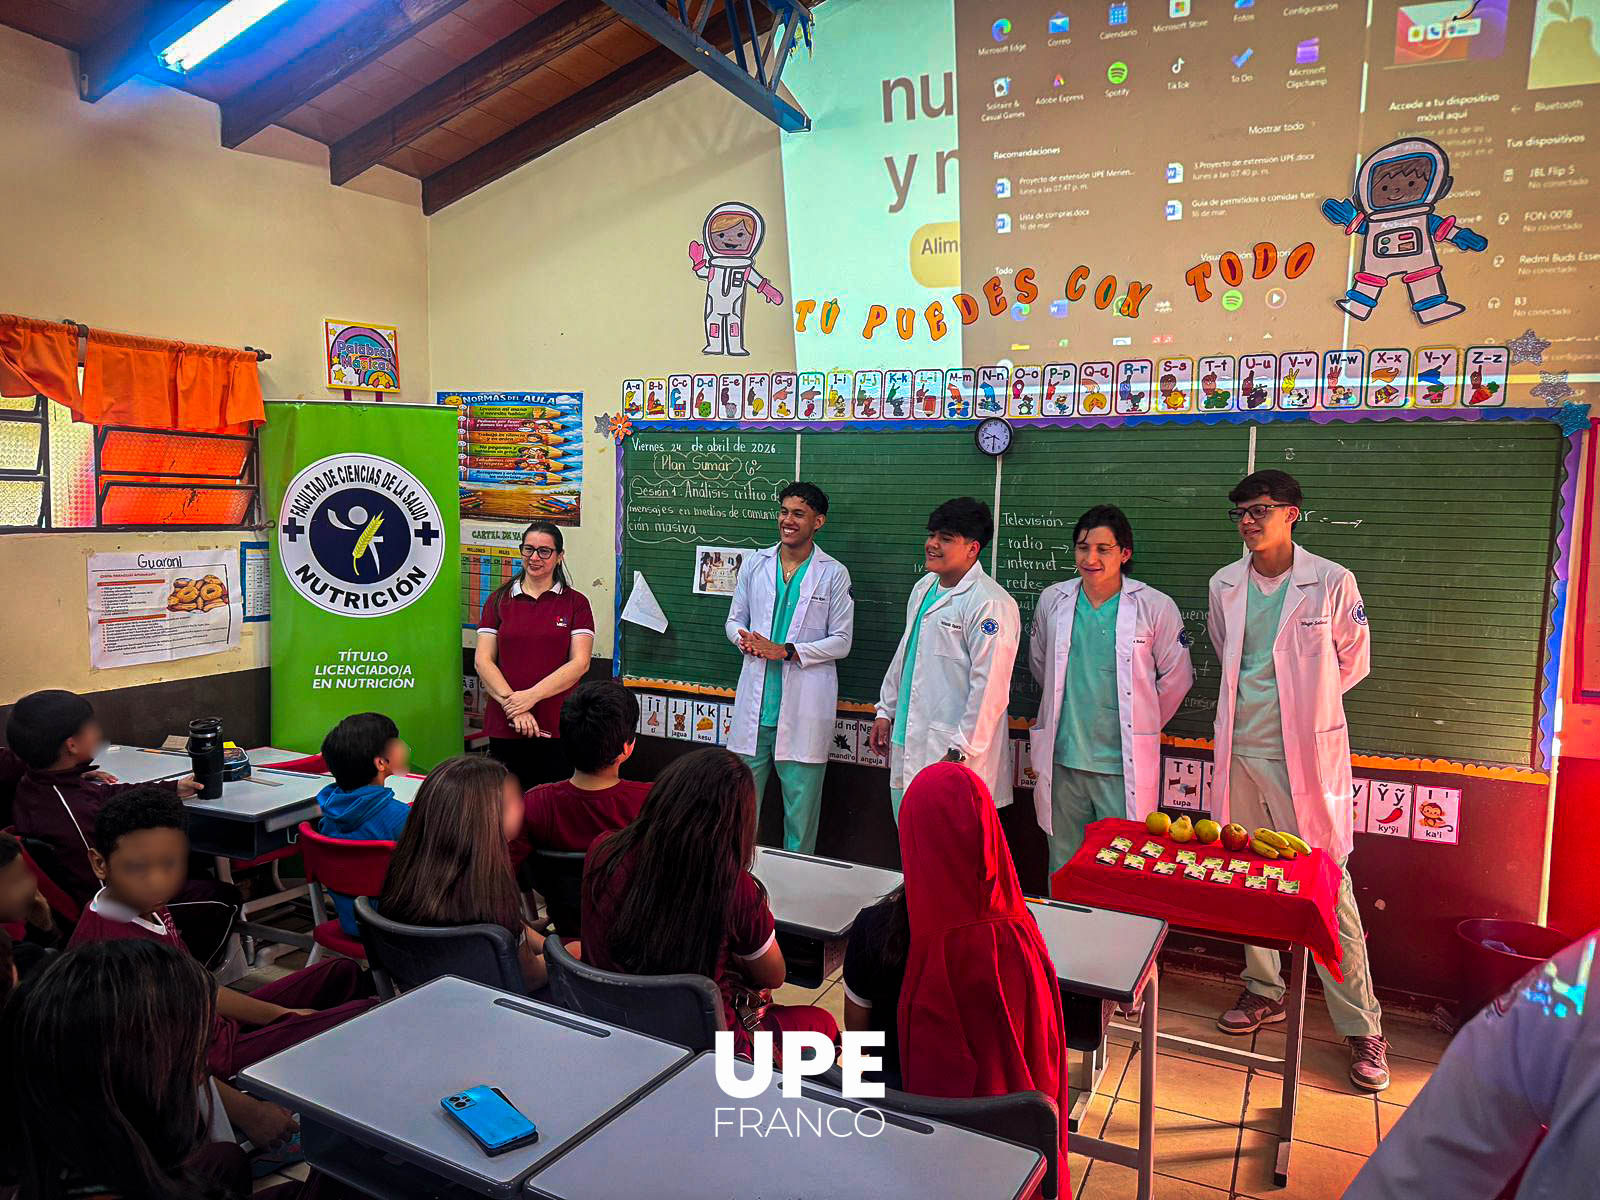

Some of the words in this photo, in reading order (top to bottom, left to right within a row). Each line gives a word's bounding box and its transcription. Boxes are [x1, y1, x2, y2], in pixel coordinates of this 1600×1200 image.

[1099, 28, 1138, 41] Calendario
[1153, 22, 1187, 33] Microsoft
[1036, 95, 1058, 105] Adobe
[1059, 94, 1085, 104] Express
[1105, 87, 1130, 98] Spotify
[1388, 98, 1423, 111] Accede
[1446, 93, 1500, 107] dispositivo
[1534, 99, 1584, 113] Bluetooth
[981, 113, 1001, 122] Casual
[1003, 110, 1025, 120] Games
[1248, 124, 1282, 135] Mostrar
[1284, 121, 1304, 132] todo
[1506, 138, 1524, 148] Tus
[1524, 134, 1585, 147] dispositivos
[1019, 175, 1048, 186] Proyecto
[1519, 254, 1550, 265] Redmi
[995, 267, 1013, 275] Todo
[795, 298, 840, 334] TÚ
[862, 267, 1039, 341] PUEDES
[1065, 265, 1152, 318] CON
[1185, 242, 1315, 303] TODO
[462, 394, 507, 404] NORMAS
[507, 394, 519, 402] DEL
[523, 394, 556, 406] AULA
[631, 437, 664, 452] Viernes
[671, 443, 682, 452] 24
[691, 436, 703, 452] de
[707, 435, 729, 452] abril
[732, 436, 746, 452] de
[751, 443, 776, 454] 2026
[661, 454, 685, 471] Plan
[692, 455, 733, 472] Sumar
[290, 477, 327, 519] FACULTAD
[322, 469, 339, 489] DE
[337, 464, 382, 486] CIENCIAS
[380, 472, 398, 491] DE
[393, 480, 409, 498] LA
[402, 491, 429, 521] SALUD
[632, 477, 669, 496] Sesión
[684, 480, 729, 498] Análisis
[629, 504, 674, 517] mensajes
[679, 508, 691, 516] en
[694, 504, 727, 518] medios
[728, 504, 740, 519] de
[1002, 510, 1063, 528] Televisión
[655, 520, 697, 535] masiva
[1008, 534, 1043, 550] radio
[1007, 551, 1057, 571] internet
[295, 563, 428, 609] NUTRICIÓN
[1006, 572, 1044, 590] redes
[338, 648, 388, 662] TÍTULO
[315, 663, 412, 678] LICENCIADO/A
[312, 677, 334, 689] EN
[336, 675, 416, 689] NUTRICIÓN
[671, 730, 687, 738] jagua
[1173, 799, 1191, 807] tupa
